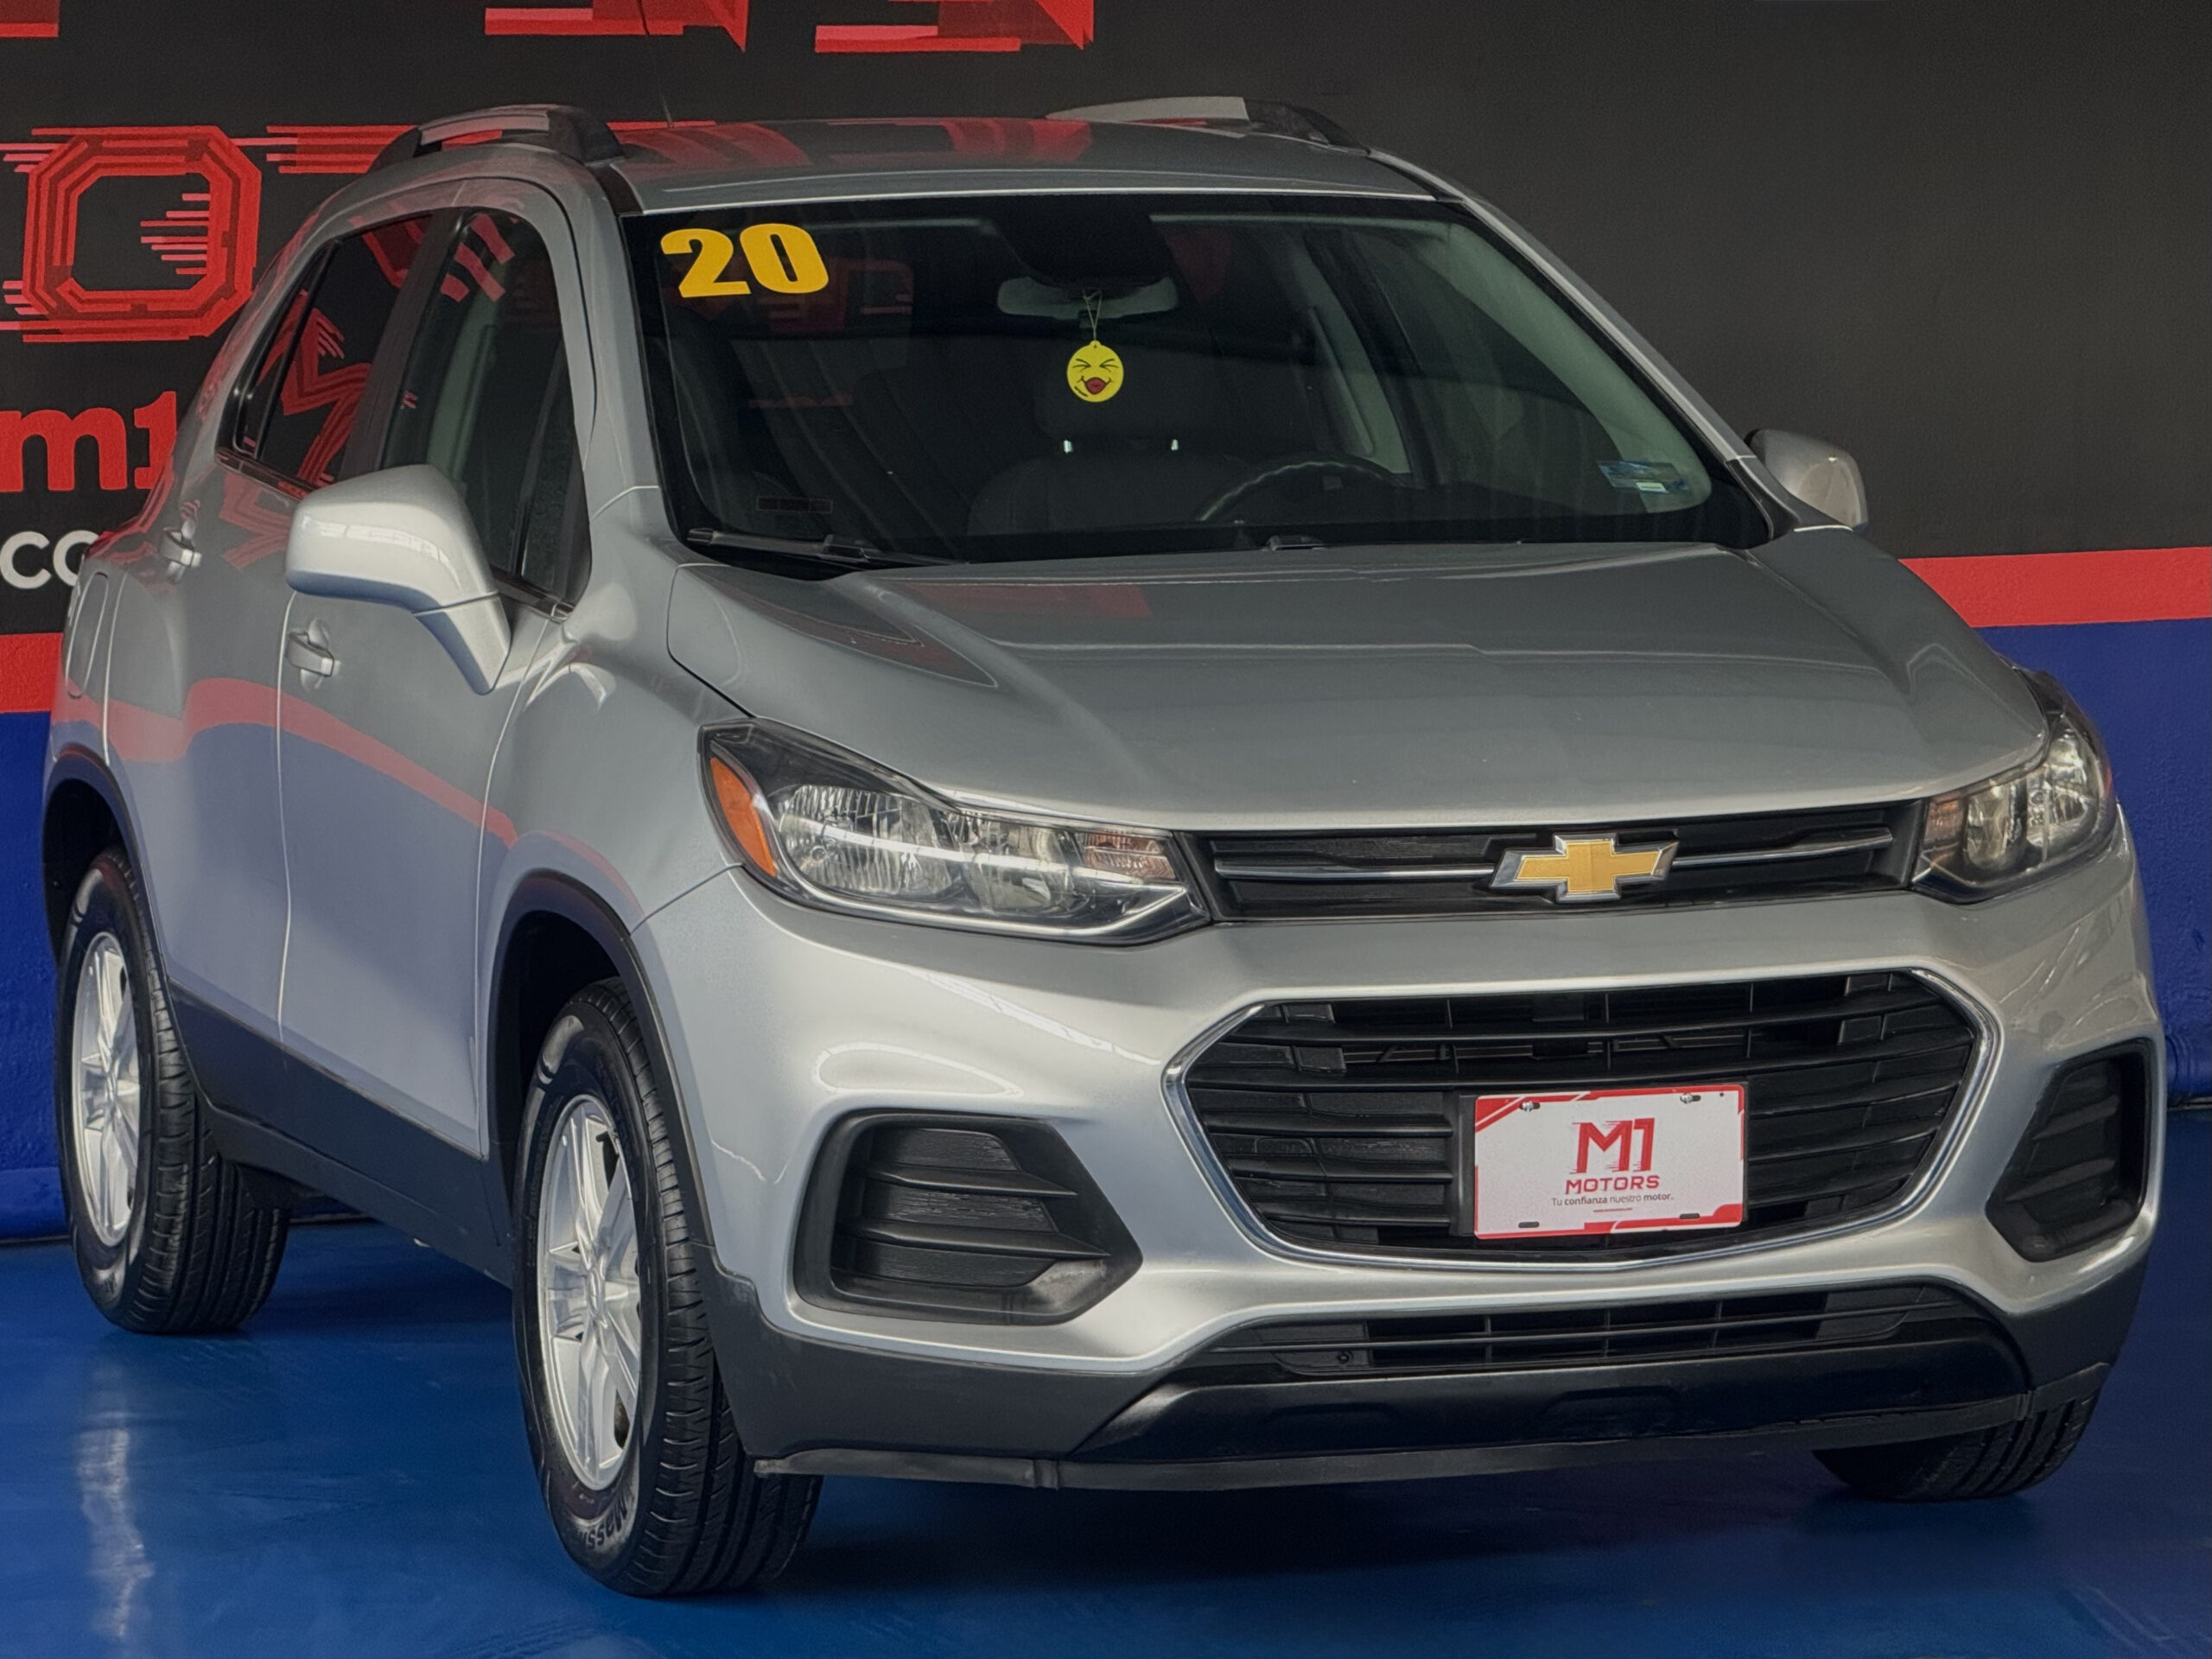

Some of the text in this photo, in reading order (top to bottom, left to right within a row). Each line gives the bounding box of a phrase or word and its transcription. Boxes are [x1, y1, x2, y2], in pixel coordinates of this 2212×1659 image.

[660, 223, 830, 298] 20
[1569, 1117, 1656, 1174] M1
[1551, 1192, 1674, 1206] Tu confianza nuestro motor.
[1565, 1175, 1661, 1195] MOTORS
